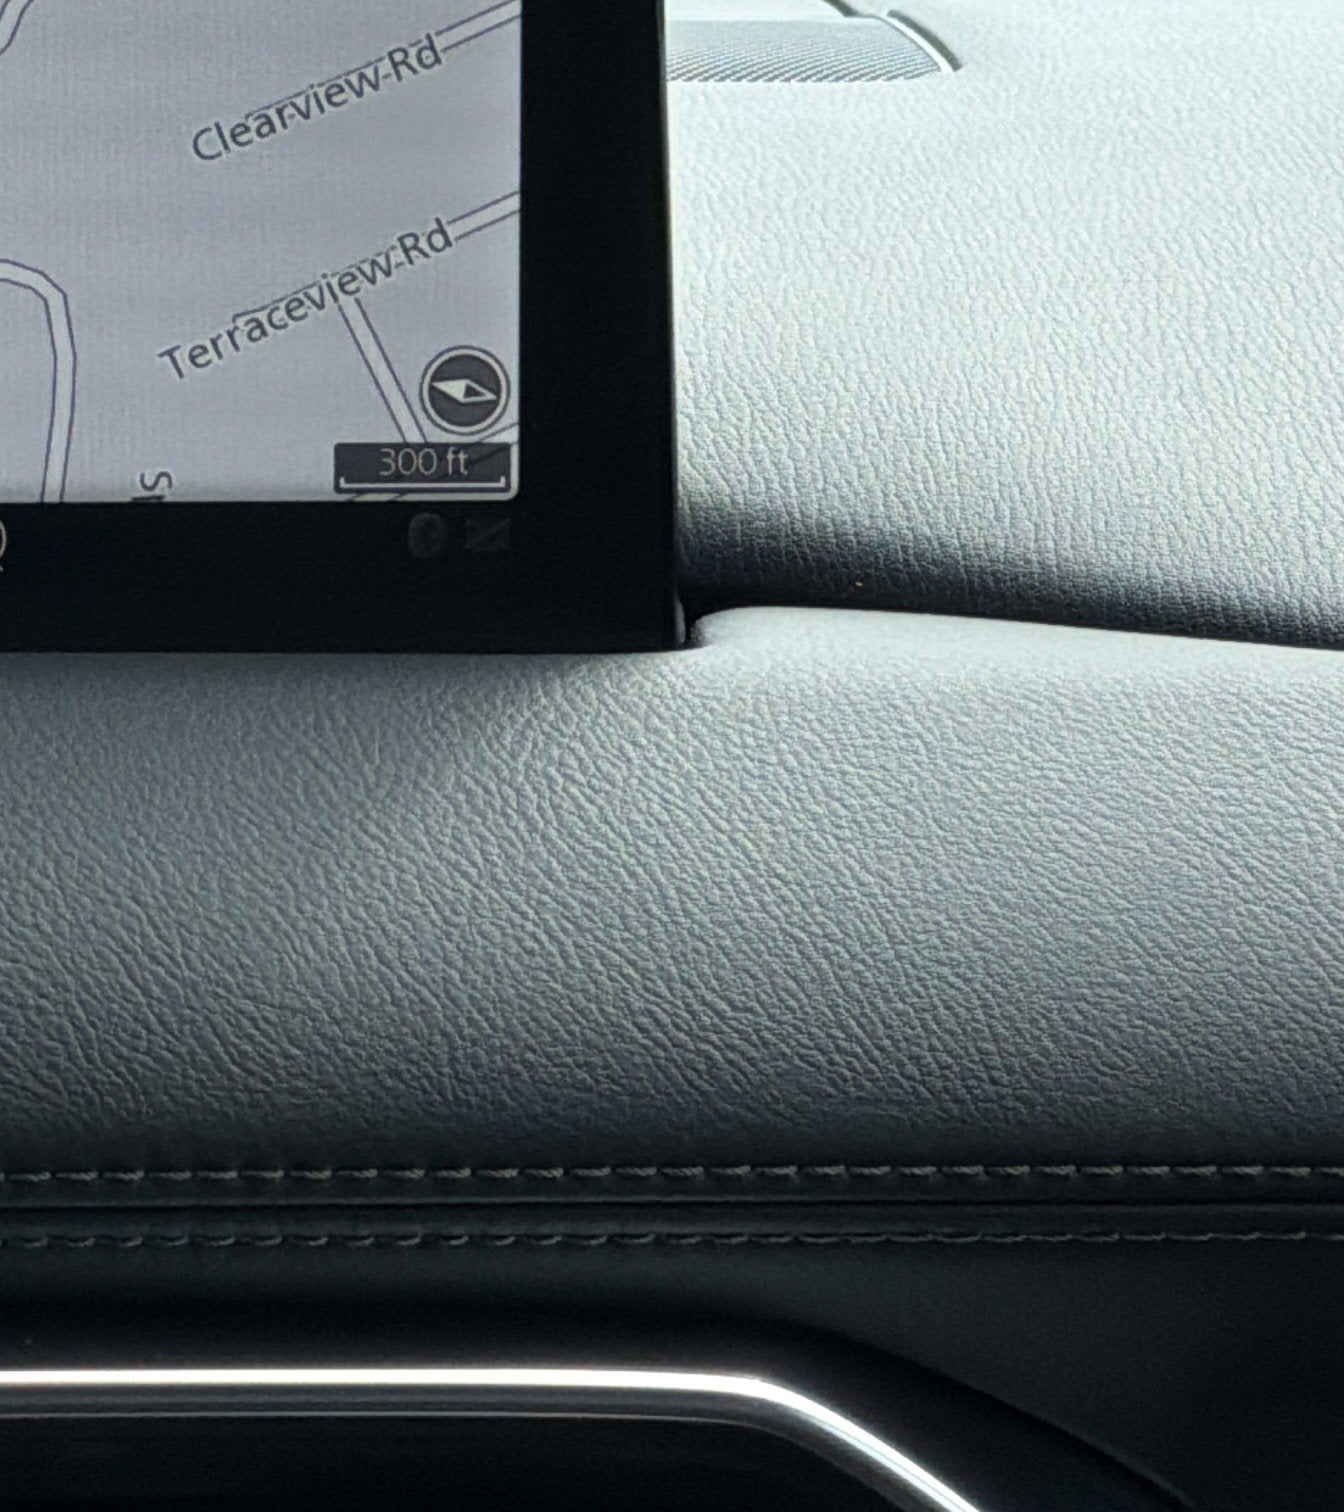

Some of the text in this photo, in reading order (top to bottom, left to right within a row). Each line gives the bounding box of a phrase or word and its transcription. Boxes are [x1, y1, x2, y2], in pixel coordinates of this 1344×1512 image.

[191, 33, 443, 161] Clearview Rd
[157, 217, 454, 379] Terraceview Rd
[378, 447, 469, 476] 300 ft
